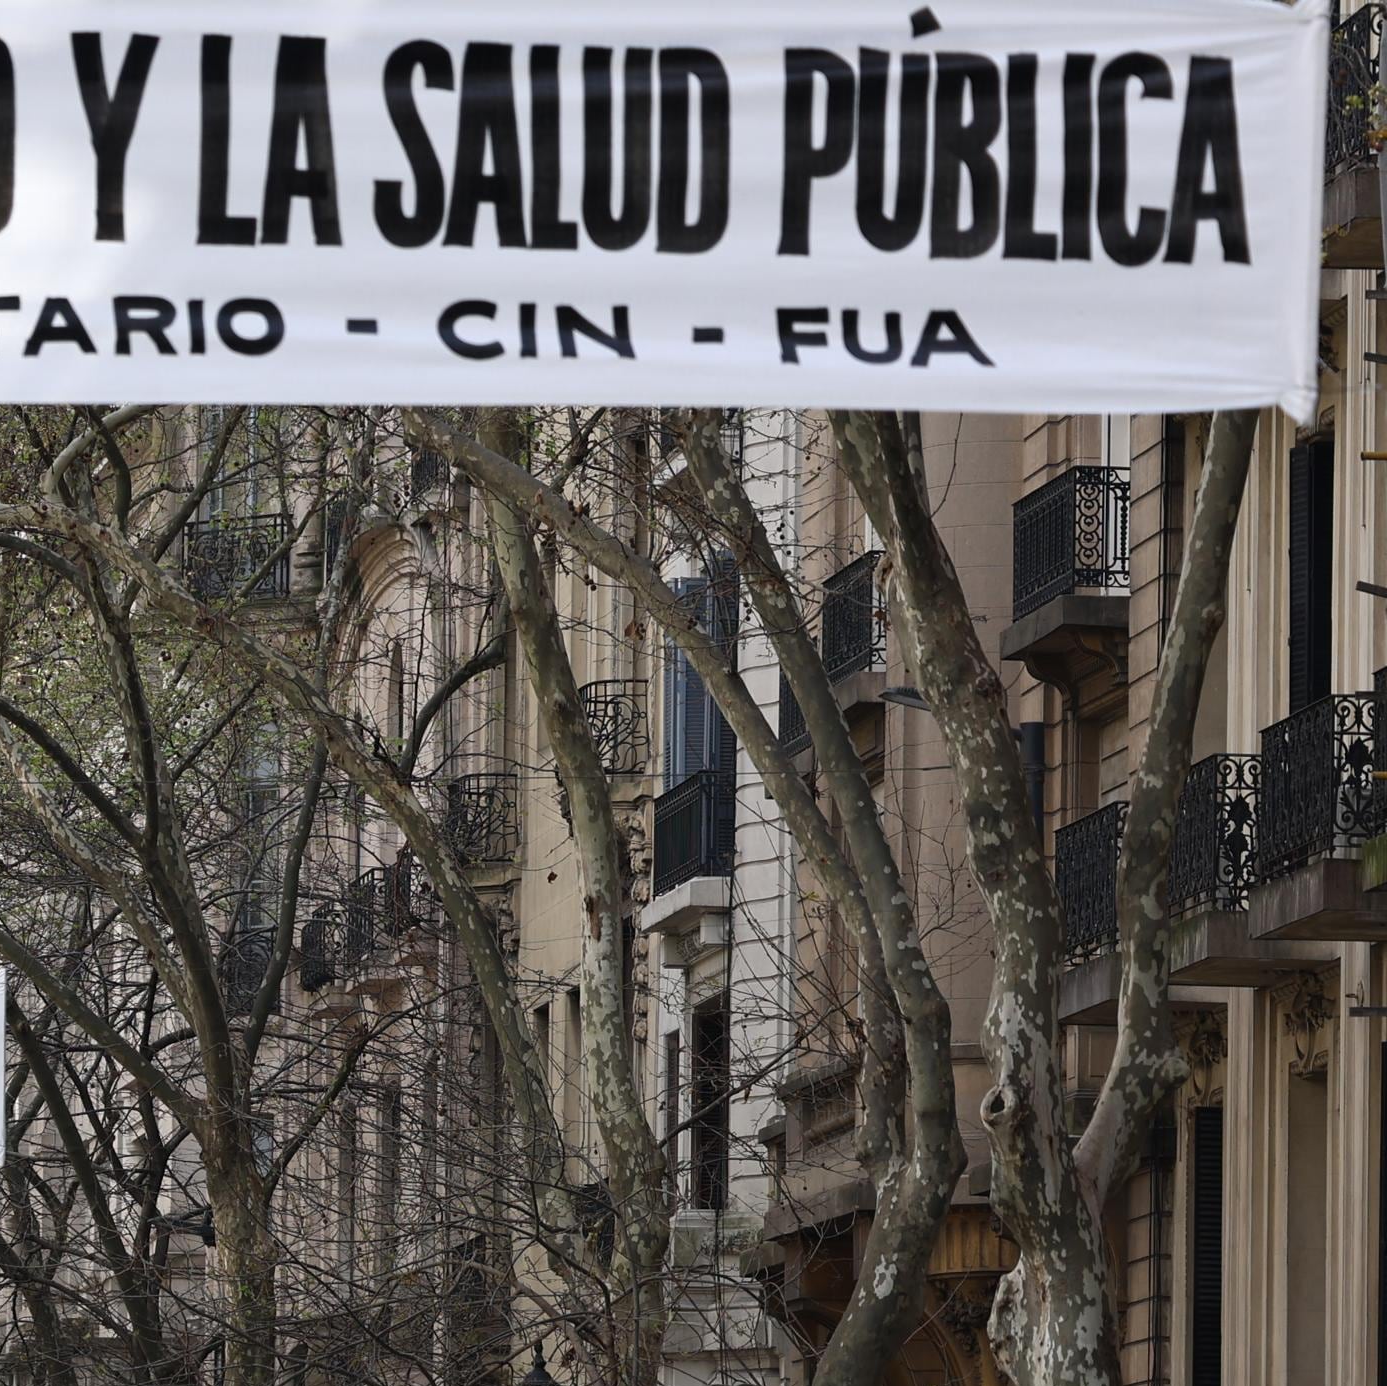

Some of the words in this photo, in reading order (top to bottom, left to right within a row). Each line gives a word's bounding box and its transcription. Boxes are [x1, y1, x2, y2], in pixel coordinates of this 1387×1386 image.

[71, 32, 160, 241] Y
[197, 34, 342, 246] LA
[374, 40, 730, 253] SALUD
[778, 8, 1250, 267] PÚBLICA
[347, 320, 377, 333] -
[438, 300, 635, 360] CIN
[693, 328, 723, 342] -
[776, 307, 993, 366] FUA
